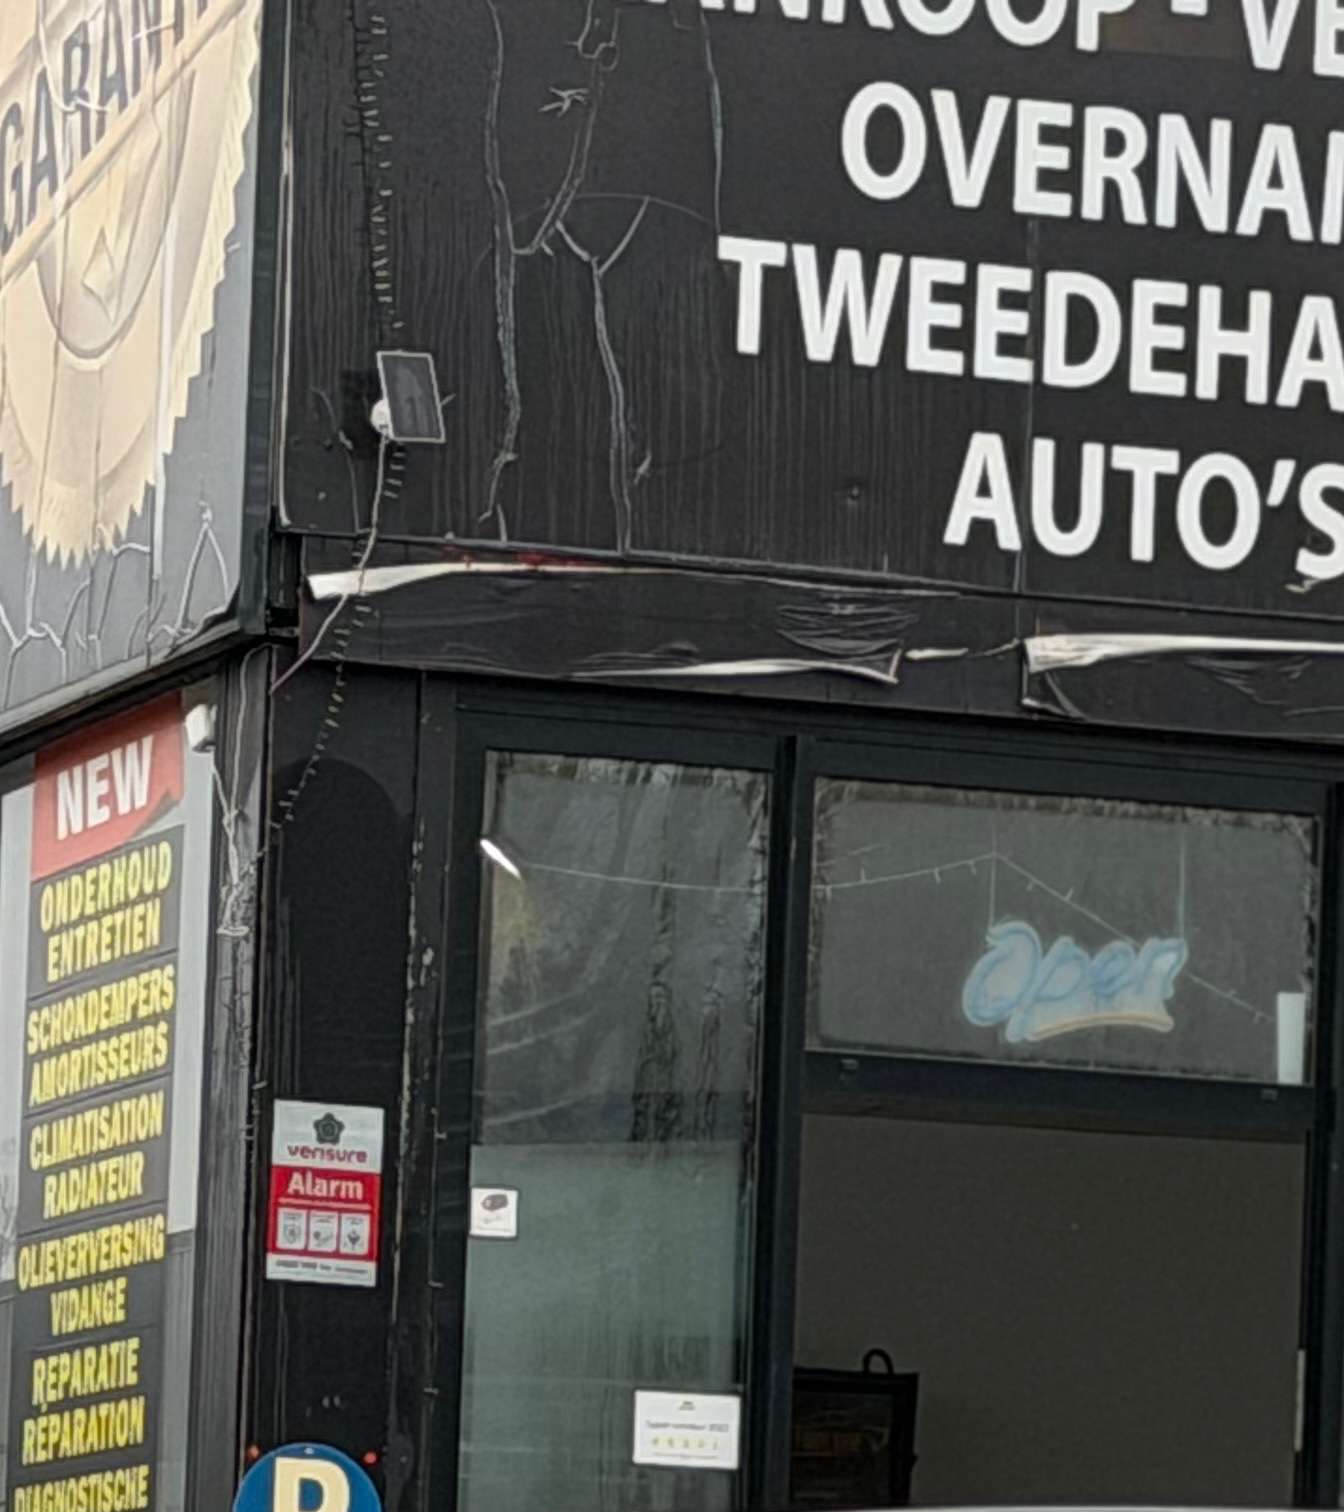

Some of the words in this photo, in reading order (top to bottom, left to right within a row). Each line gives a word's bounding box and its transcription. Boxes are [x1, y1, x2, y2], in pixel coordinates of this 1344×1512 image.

[56, 732, 154, 841] NEW
[40, 840, 172, 933] ONDERHOUD
[47, 897, 161, 983] ENTRETIEN
[962, 920, 1190, 1043] Open
[27, 963, 175, 1055] SCHOKDEMPERS
[28, 1020, 169, 1107] AMORTISSEURS
[29, 1089, 165, 1172] CLIMATISATION
[287, 1143, 369, 1164] verisure
[43, 1150, 145, 1220] RADIATEUR
[287, 1170, 364, 1201] Alarm
[17, 1213, 166, 1291] OLIEVERVERSING
[50, 1276, 128, 1336] VIDANGE
[32, 1336, 141, 1406] REPARATIE
